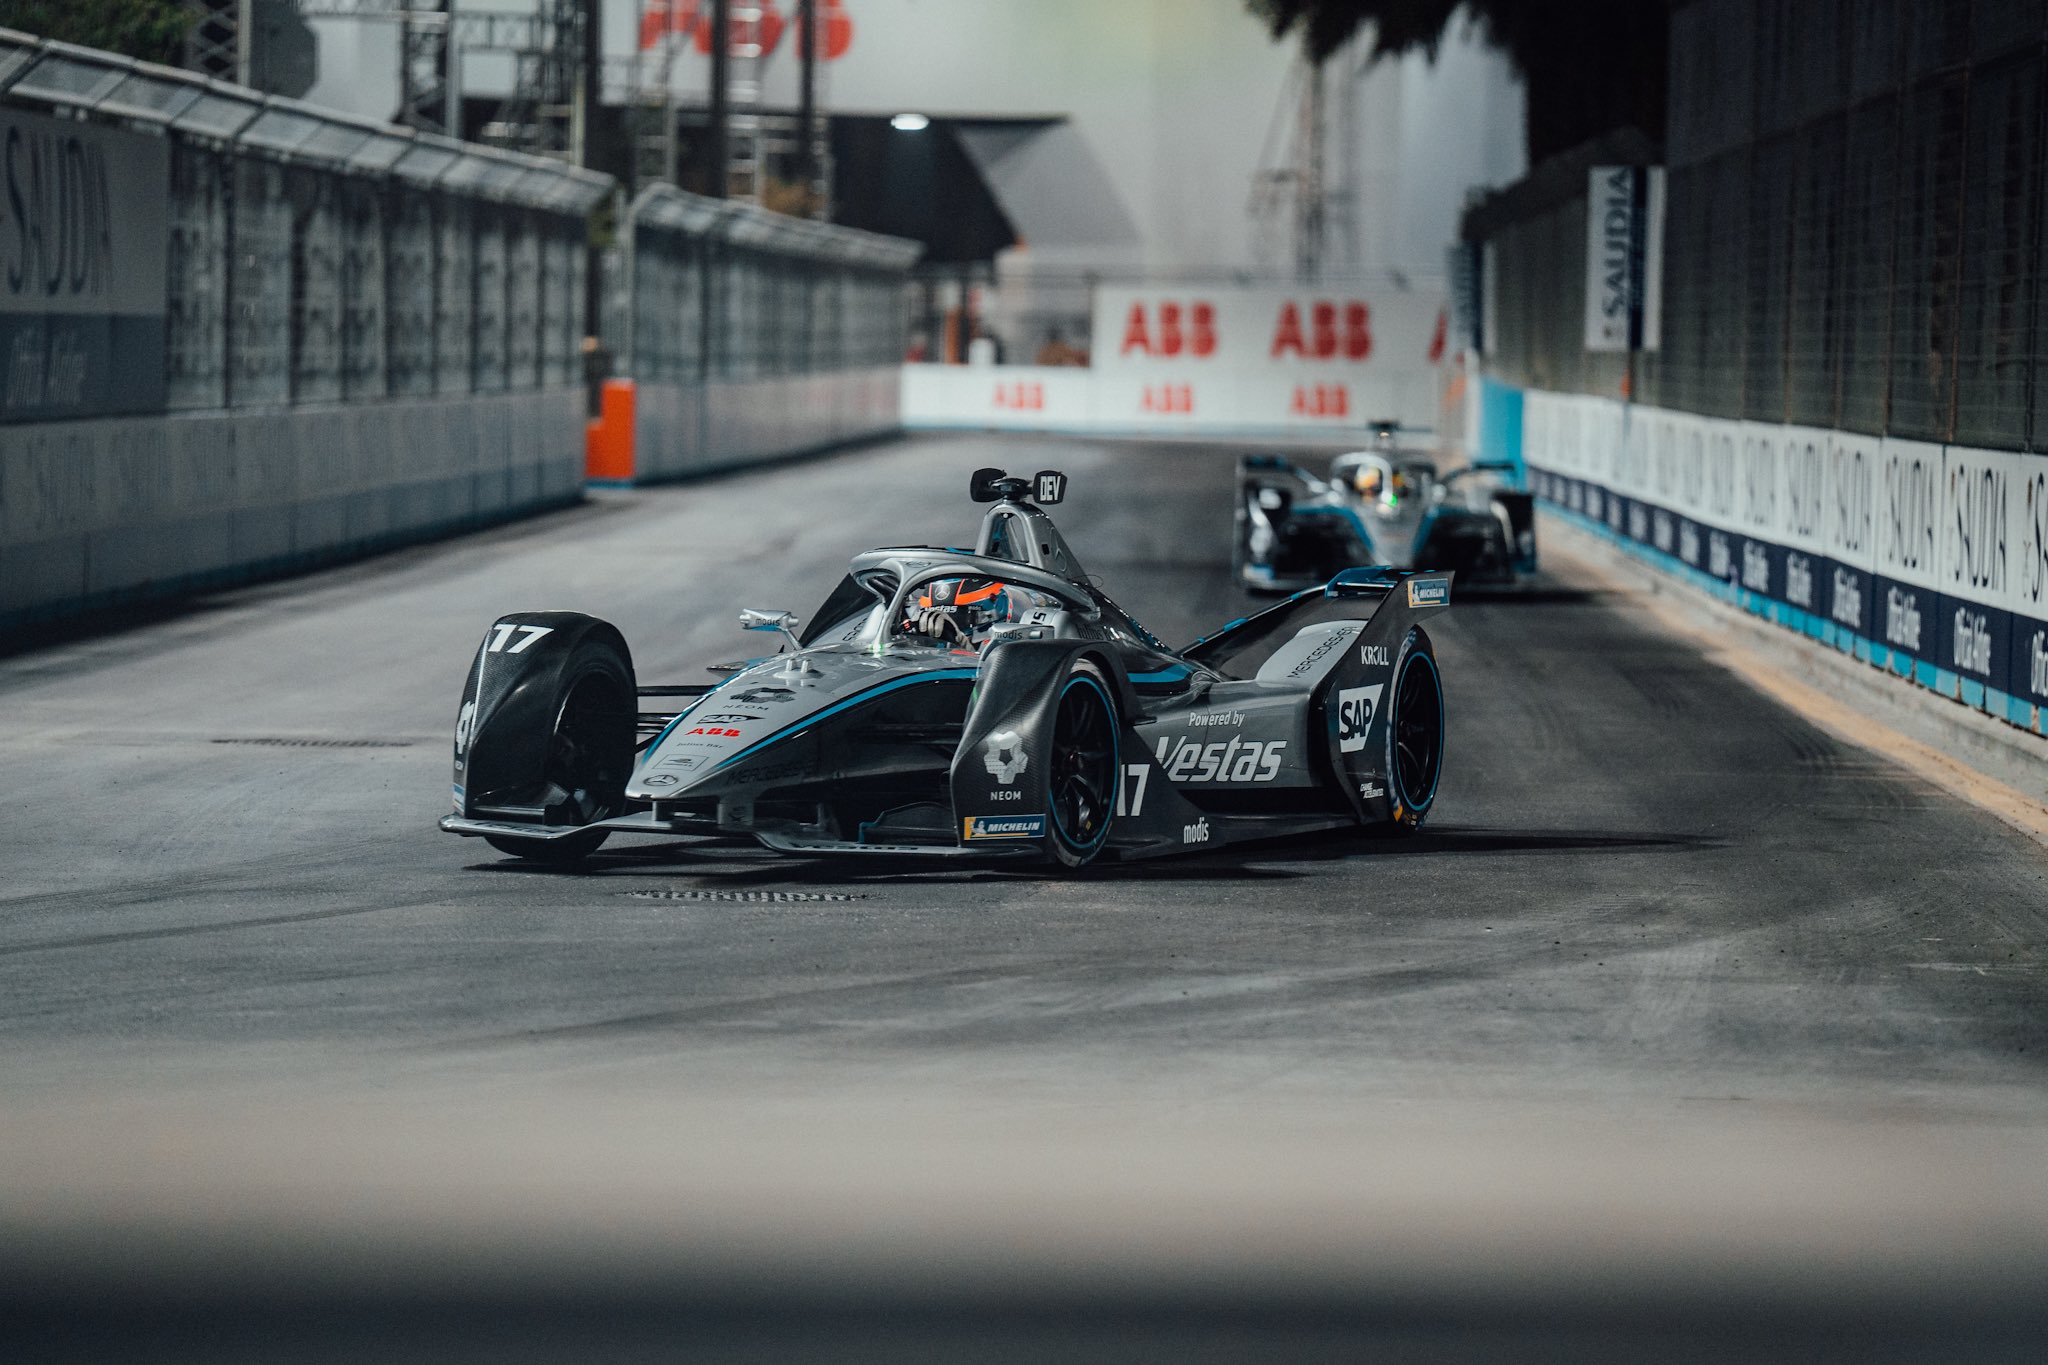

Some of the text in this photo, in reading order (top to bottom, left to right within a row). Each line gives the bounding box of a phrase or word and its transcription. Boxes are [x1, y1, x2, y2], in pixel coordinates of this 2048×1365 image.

[1602, 166, 1632, 318] SAUDIA
[1119, 300, 1216, 357] ABB
[1269, 299, 1371, 360] ABB
[994, 382, 1044, 410] ABB
[1142, 383, 1193, 413] ABB
[1290, 384, 1348, 417] ABB
[1040, 475, 1061, 501] DEV
[1954, 463, 2007, 593] SAUDIA
[1420, 588, 1445, 598] MICHELIN
[488, 623, 554, 654] 17
[994, 631, 1022, 640] modis
[684, 727, 741, 737] ABB
[699, 714, 749, 723] SAP
[1188, 710, 1245, 727] Powered by
[1340, 698, 1372, 741] SAP
[1155, 734, 1287, 782] Vestas
[990, 791, 1021, 801] NEOM
[987, 822, 1040, 832] MICHELIN
[1183, 816, 1209, 843] modis
